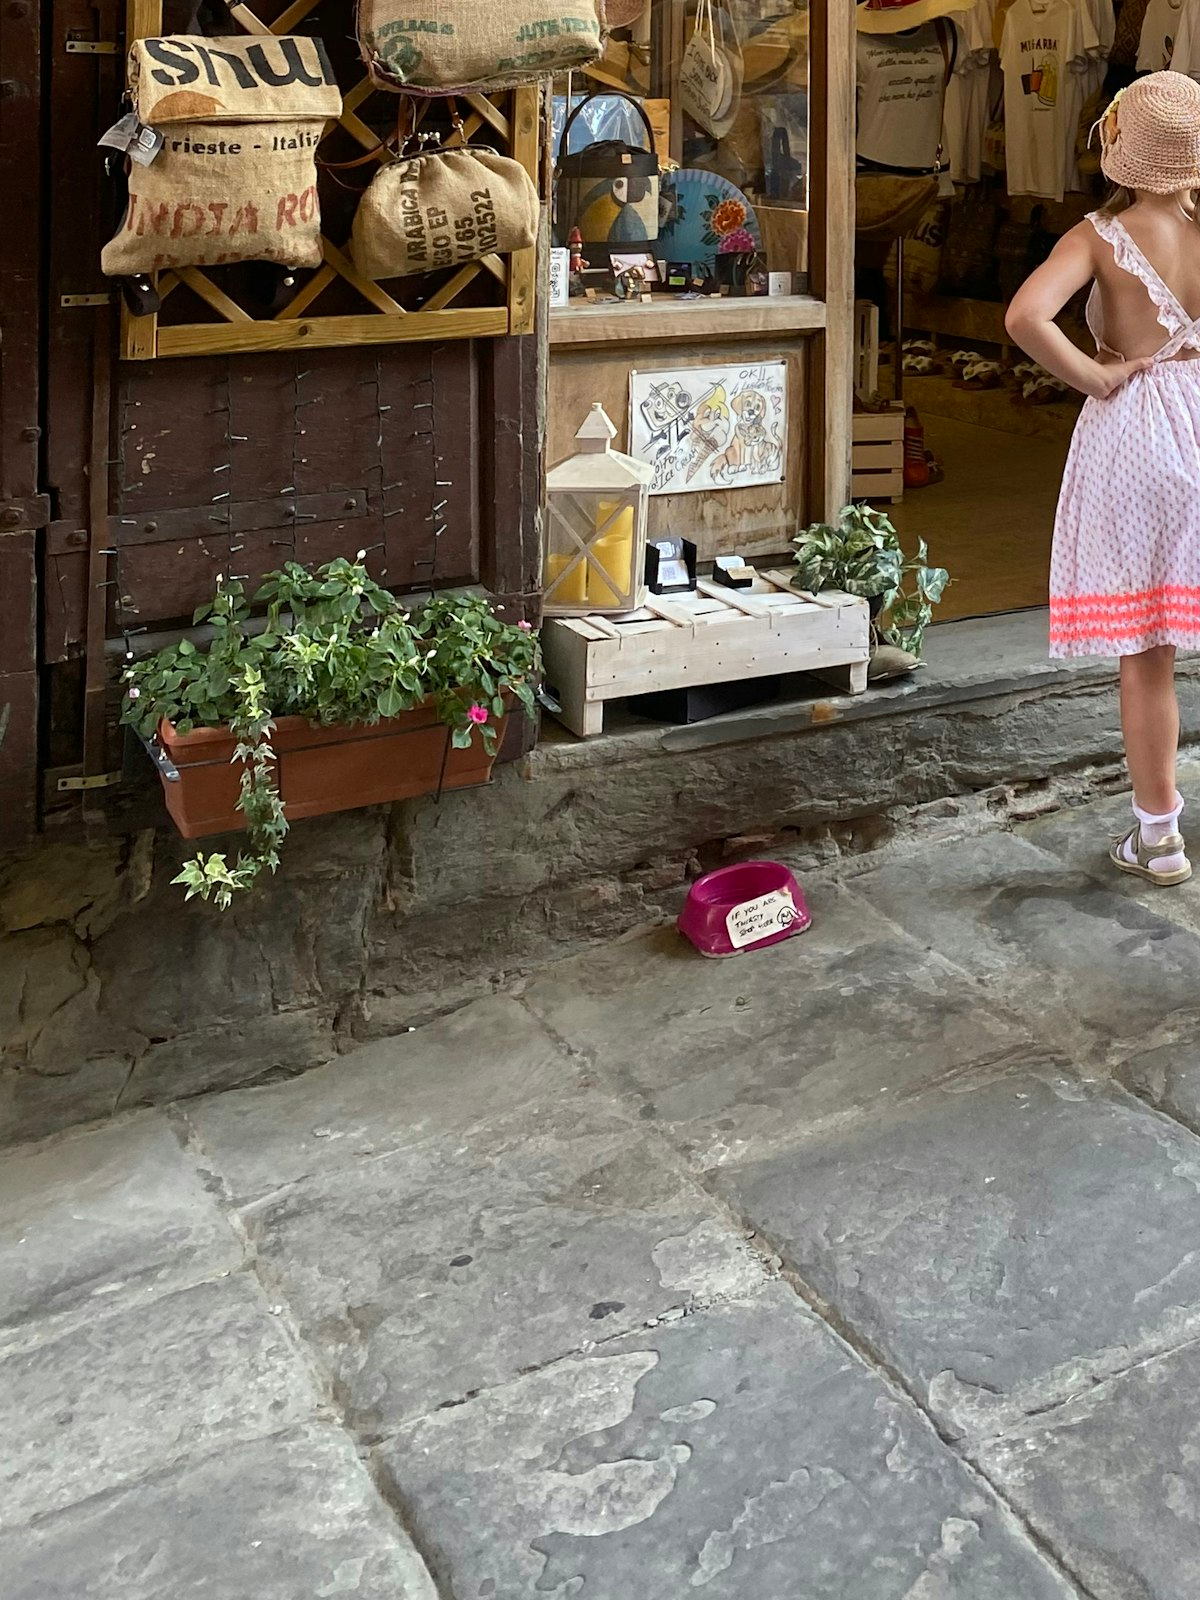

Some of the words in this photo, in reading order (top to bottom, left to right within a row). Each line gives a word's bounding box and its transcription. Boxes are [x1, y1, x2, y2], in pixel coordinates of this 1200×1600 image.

[516, 19, 560, 42] JUTE
[127, 193, 260, 238] INDIA
[400, 188, 428, 262] ARABICA
[469, 188, 498, 253] 102522
[744, 904, 758, 915] YOU
